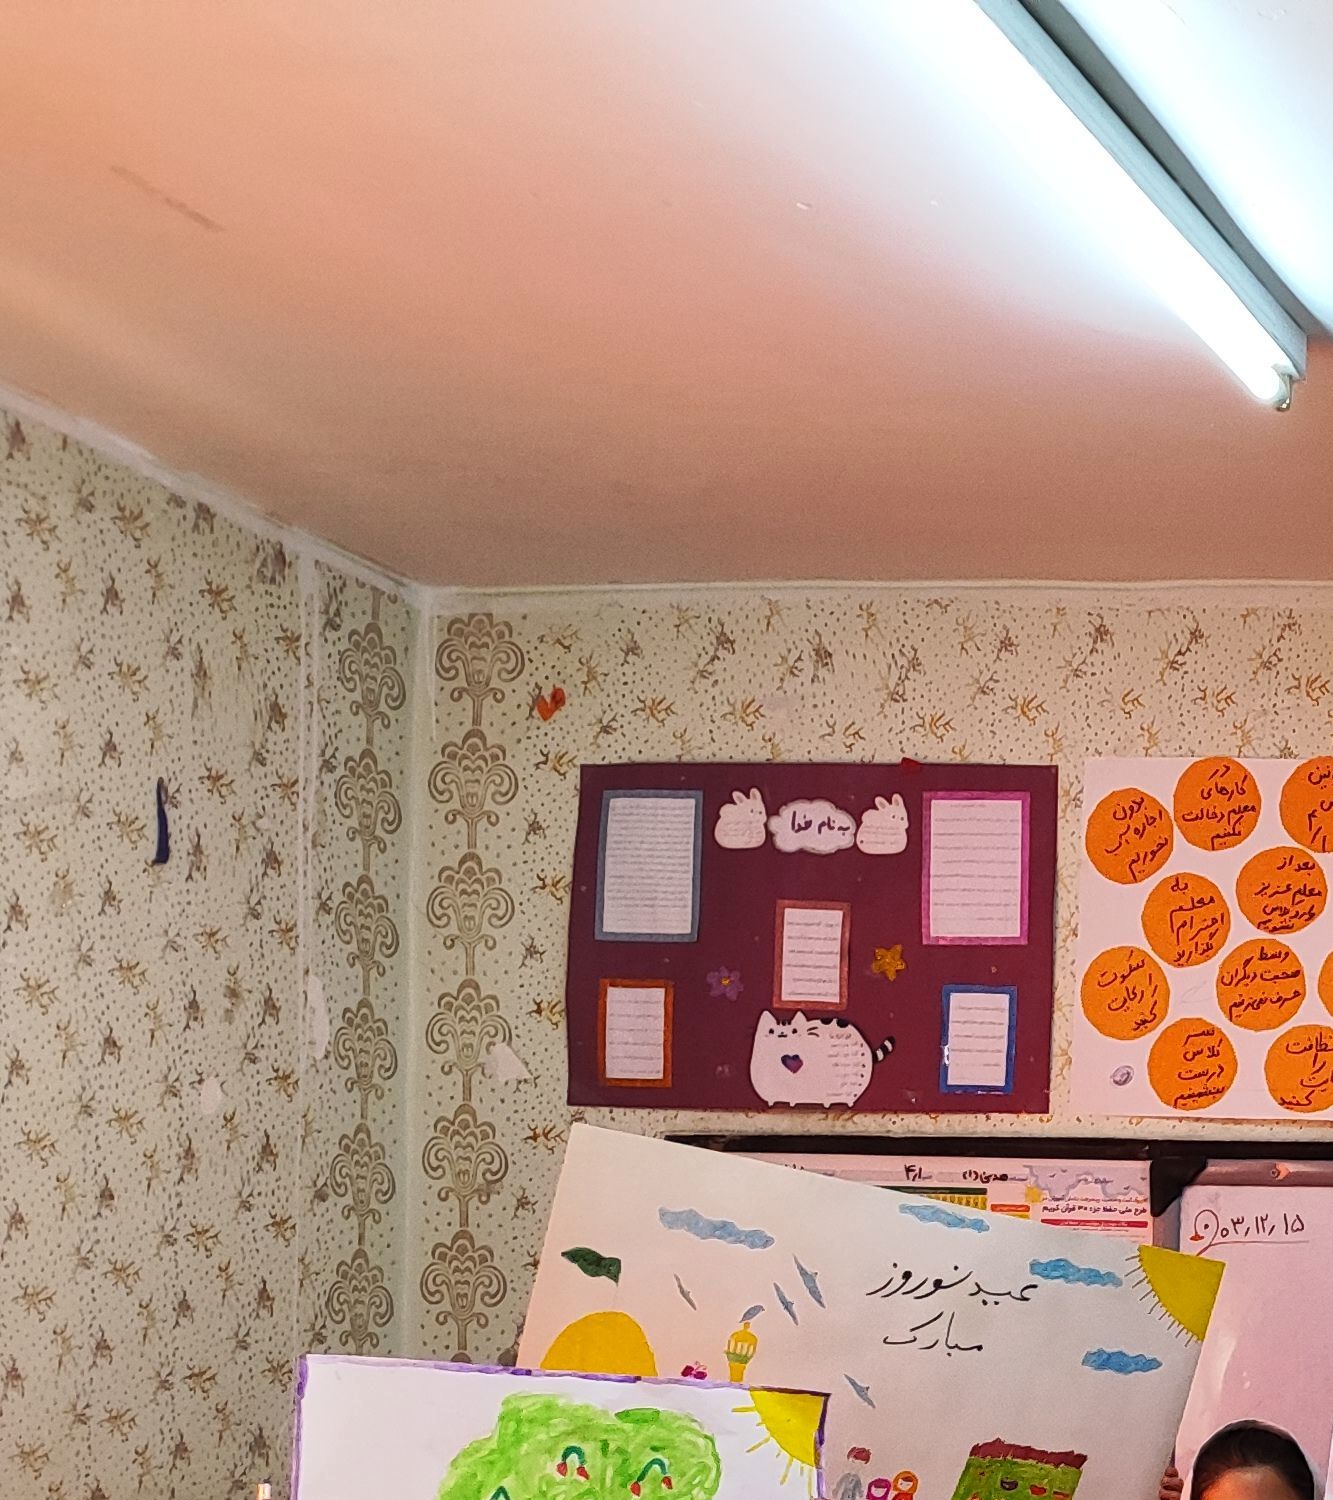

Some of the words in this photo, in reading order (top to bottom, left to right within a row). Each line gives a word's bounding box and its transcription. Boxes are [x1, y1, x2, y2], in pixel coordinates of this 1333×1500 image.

[1207, 764, 1231, 781] در
[1112, 796, 1146, 821] بدون
[1181, 805, 1226, 823] دخالت
[1228, 803, 1257, 824] معلم
[791, 810, 813, 834] خدا
[817, 815, 836, 835] نام
[1132, 809, 1164, 840] اجازه
[1276, 855, 1294, 871] از
[1170, 876, 1189, 896] به
[1254, 882, 1292, 899] عزیز
[1291, 883, 1323, 905] معلم
[1169, 895, 1216, 934] معلم
[1175, 912, 1225, 945] احترام
[1257, 946, 1290, 962] وسط
[1097, 949, 1146, 988] سکوت
[1220, 955, 1257, 987] دیگران
[1260, 968, 1301, 983] صحبت
[1182, 1037, 1224, 1062] کلاس
[1177, 1064, 1225, 1082] درست
[1310, 1052, 1327, 1075] را
[1278, 1089, 1316, 1110] کنید
[1042, 1204, 1060, 1213] کریم
[1061, 1203, 1077, 1214] قرآن
[865, 1262, 975, 1300] نوروز
[968, 1281, 1039, 1306] عید
[882, 1311, 984, 1357] مبارک
